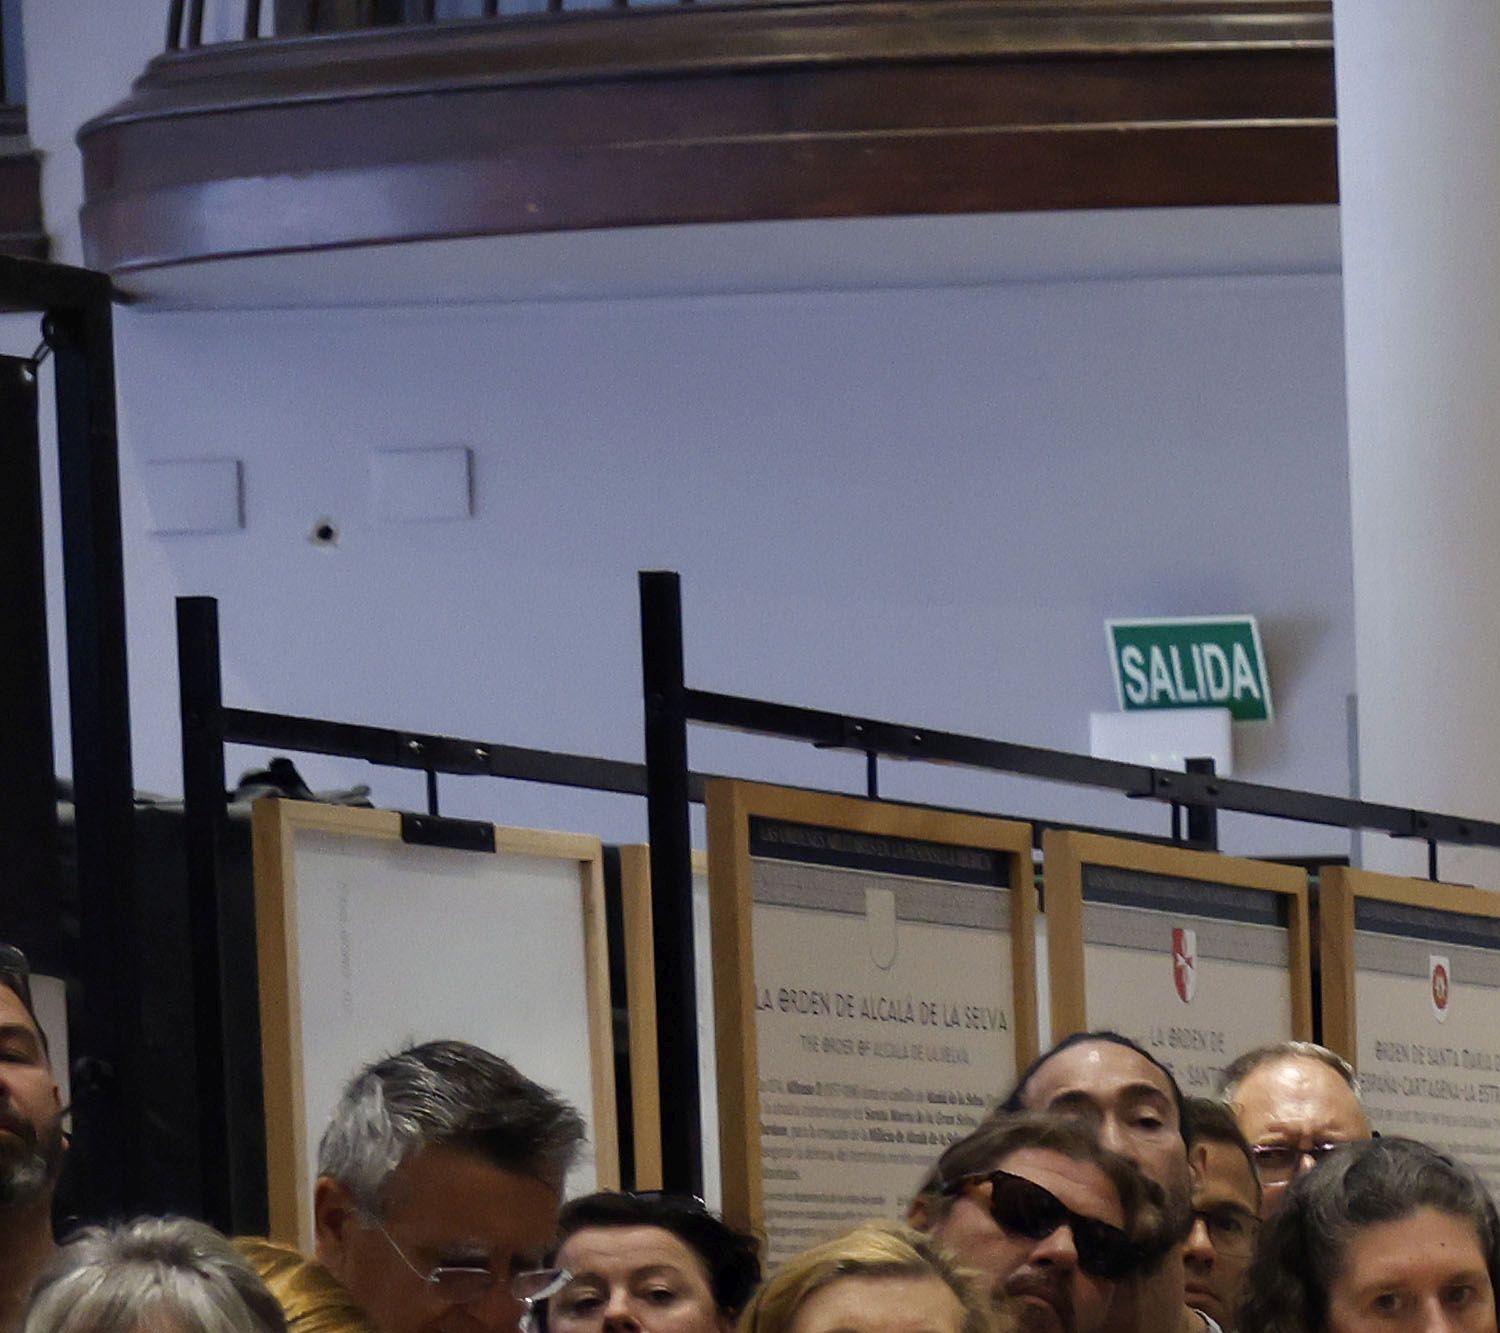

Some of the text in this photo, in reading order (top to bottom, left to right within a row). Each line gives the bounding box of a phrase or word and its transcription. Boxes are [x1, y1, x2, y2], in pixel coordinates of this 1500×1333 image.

[1120, 642, 1260, 704] SALIDA
[835, 993, 855, 1018] DE
[920, 1000, 938, 1026] DE
[943, 1003, 961, 1028] LA
